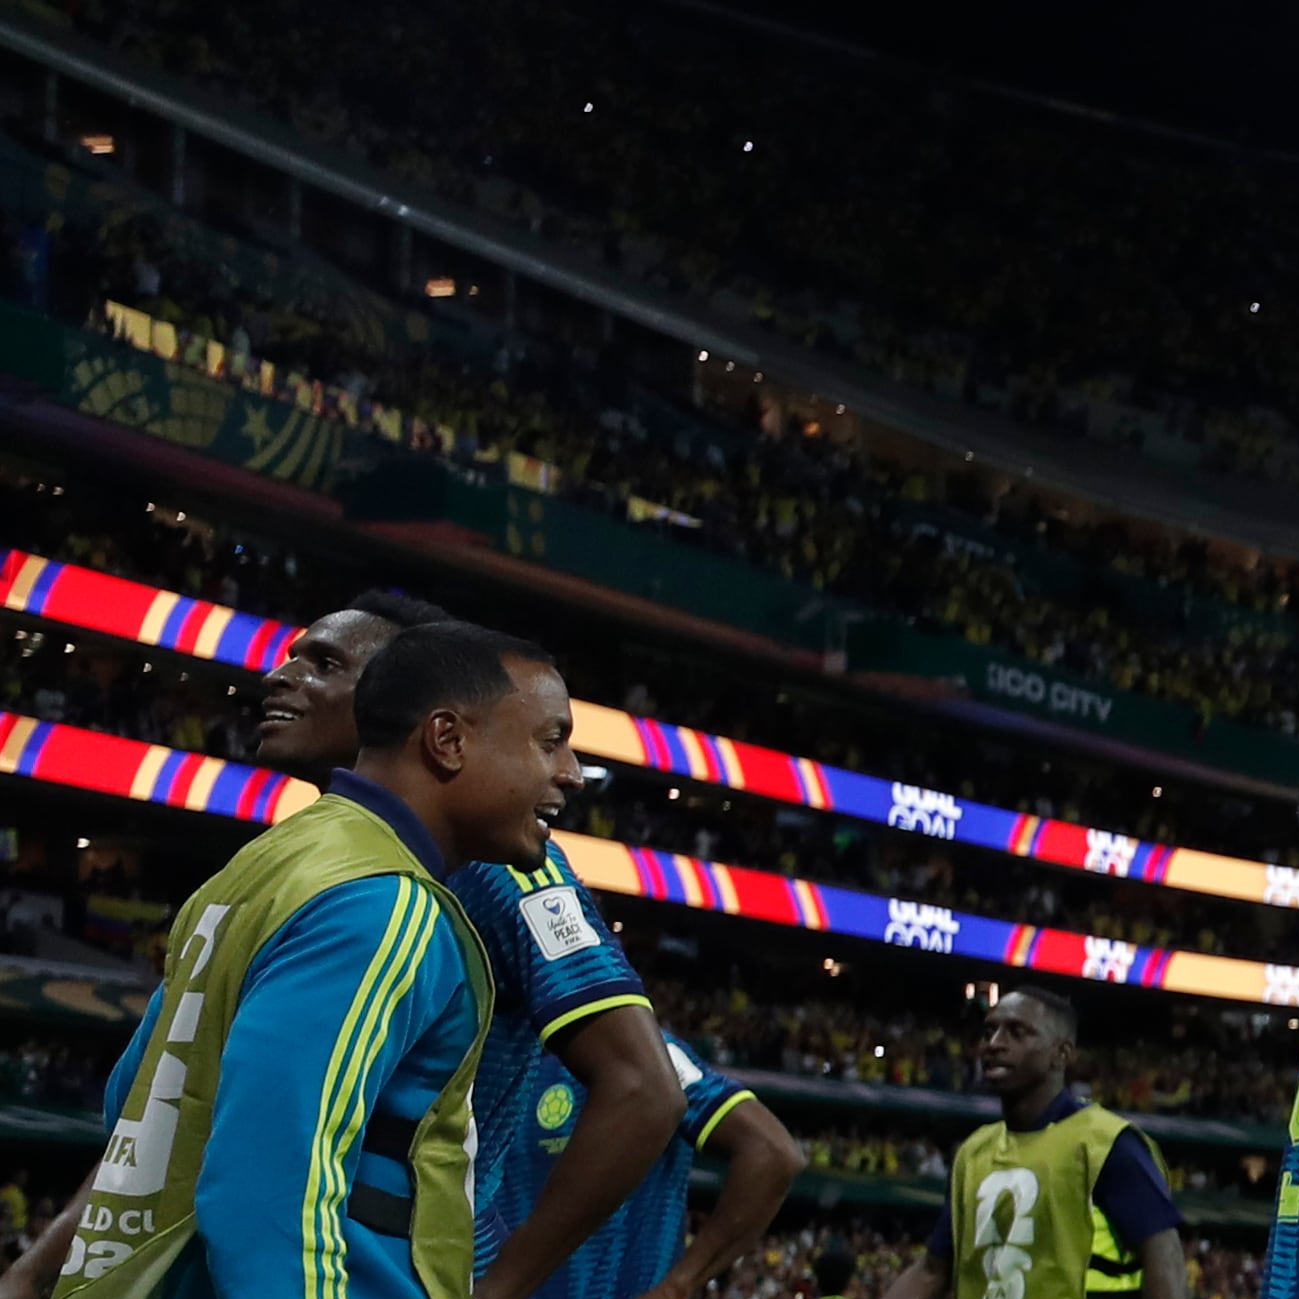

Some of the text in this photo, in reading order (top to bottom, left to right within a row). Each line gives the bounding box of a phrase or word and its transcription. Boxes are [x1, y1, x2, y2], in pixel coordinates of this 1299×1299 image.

[1049, 681, 1113, 723] CITY
[104, 1135, 137, 1168] IFA
[60, 1235, 134, 1279] 02
